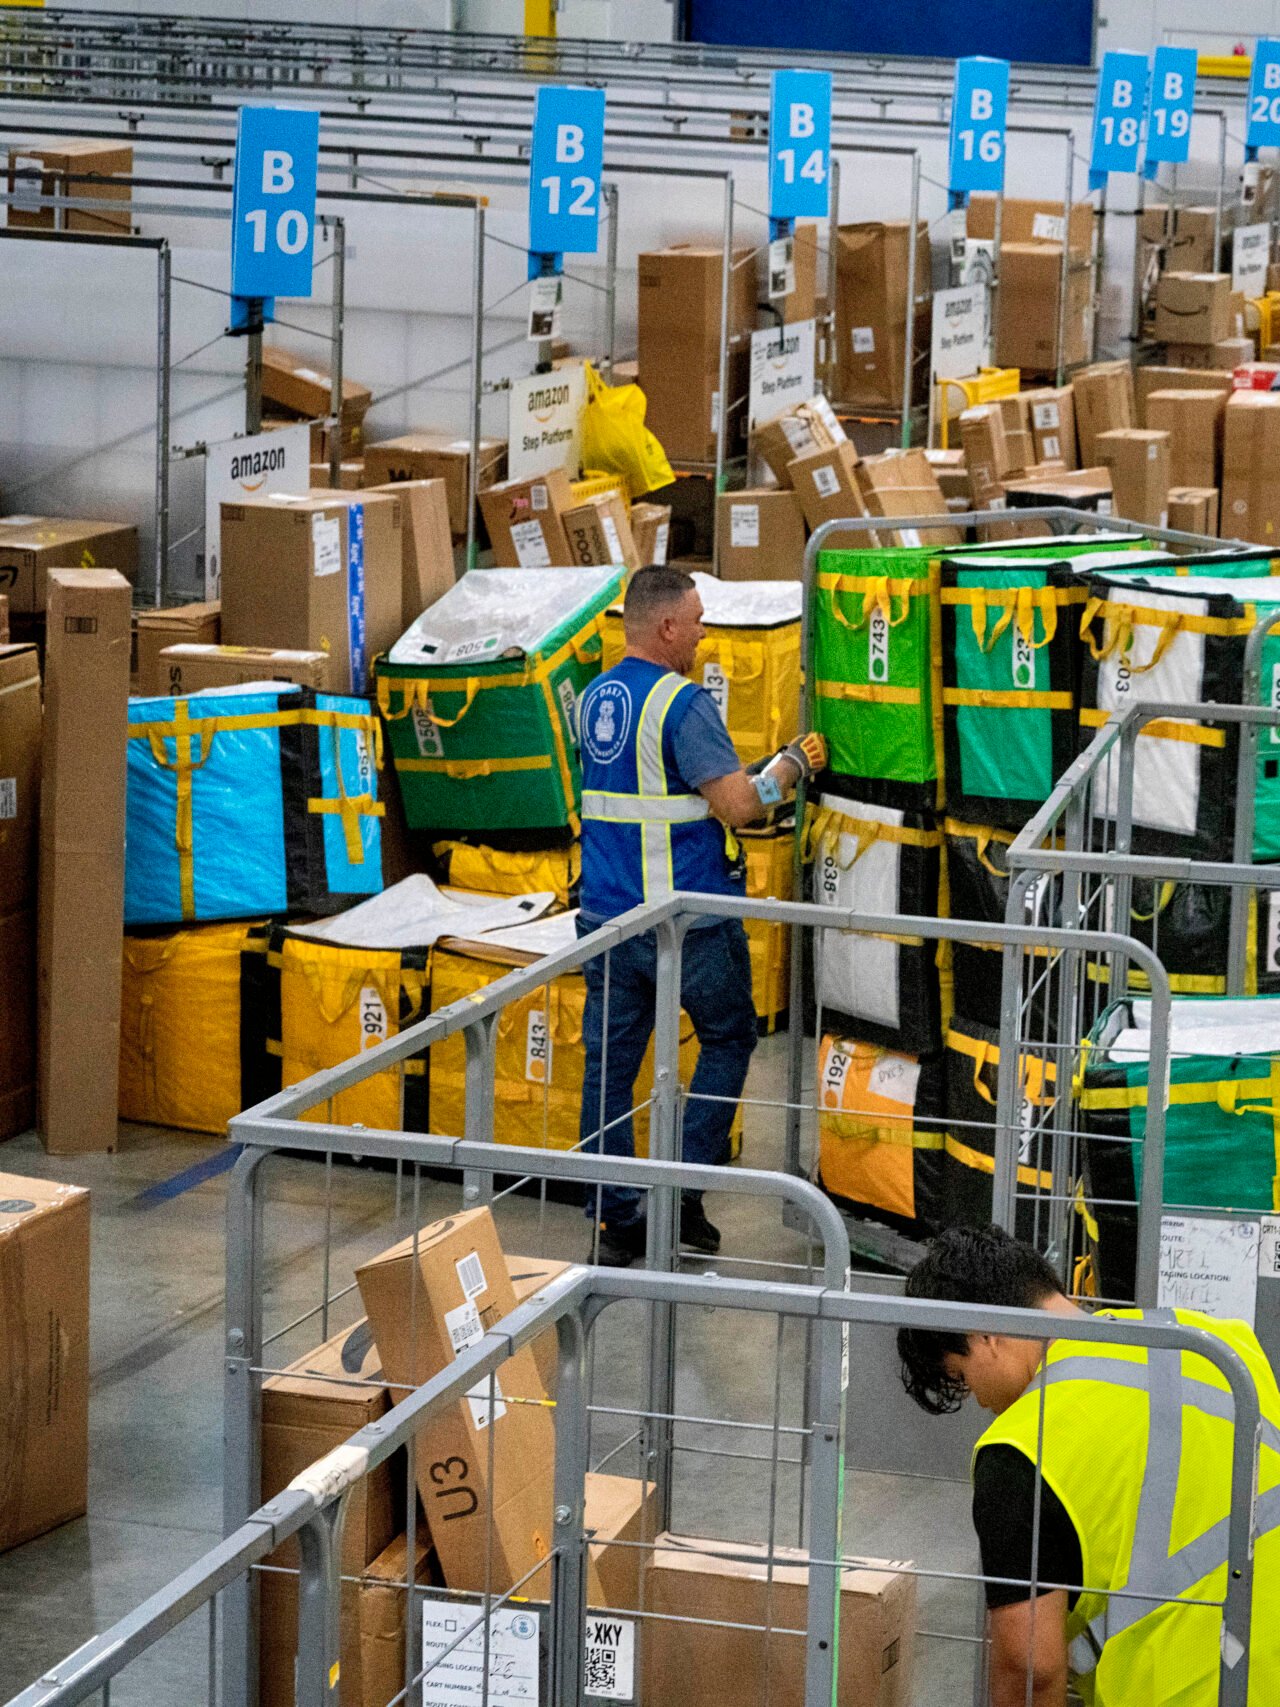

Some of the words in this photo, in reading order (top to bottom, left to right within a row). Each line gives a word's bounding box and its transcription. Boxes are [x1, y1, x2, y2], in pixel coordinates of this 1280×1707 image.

[1112, 80, 1132, 108] B
[1164, 72, 1183, 100] B
[789, 103, 815, 138] B
[970, 88, 994, 120] B
[1101, 117, 1137, 147] 18
[1153, 108, 1190, 138] 19
[555, 125, 585, 163] B
[959, 129, 1001, 163] 16
[261, 150, 295, 194] B
[777, 149, 826, 185] 14
[540, 176, 596, 216] 12
[244, 209, 309, 255] 10
[527, 384, 569, 412] amazon
[522, 432, 539, 451] Step
[541, 427, 573, 446] Platform
[231, 445, 285, 481] amazon
[456, 641, 483, 656] 508
[872, 619, 884, 655] 743
[364, 1002, 382, 1033] 921
[531, 1024, 546, 1058] 843
[826, 1055, 847, 1087] 192
[429, 1456, 478, 1521] U3
[594, 1622, 622, 1647] XKY
